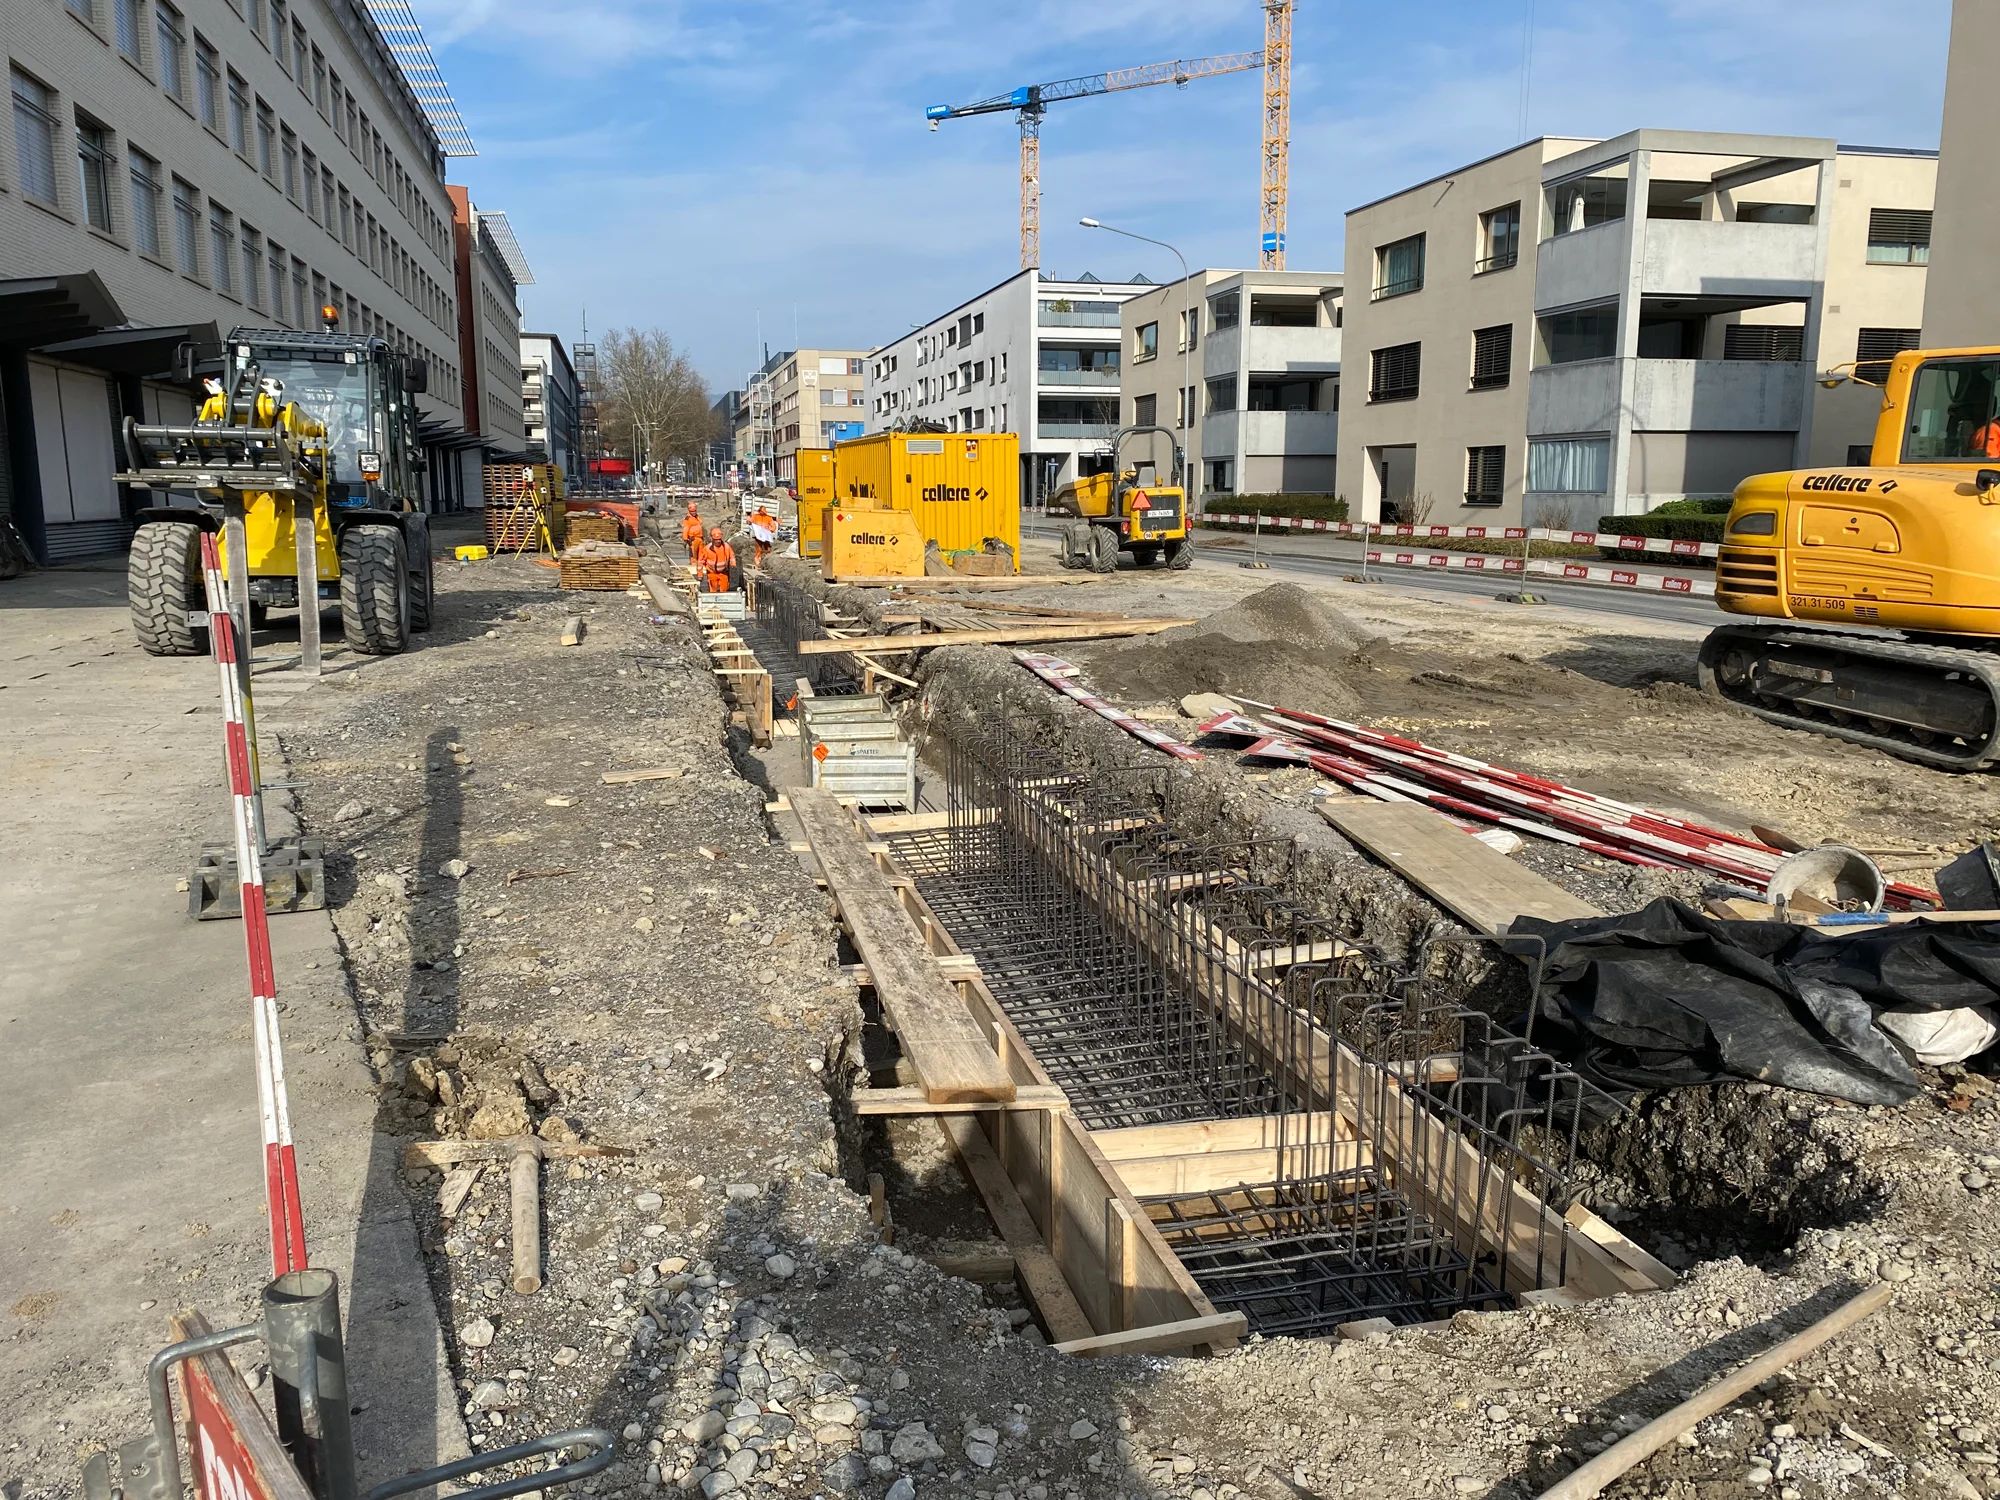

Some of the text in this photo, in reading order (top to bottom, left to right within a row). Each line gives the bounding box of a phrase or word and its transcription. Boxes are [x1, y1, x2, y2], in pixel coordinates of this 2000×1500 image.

[1802, 474, 1873, 493] cellere
[922, 483, 970, 502] cellere
[851, 532, 886, 545] cellere
[1790, 596, 1846, 610] 321.31.509
